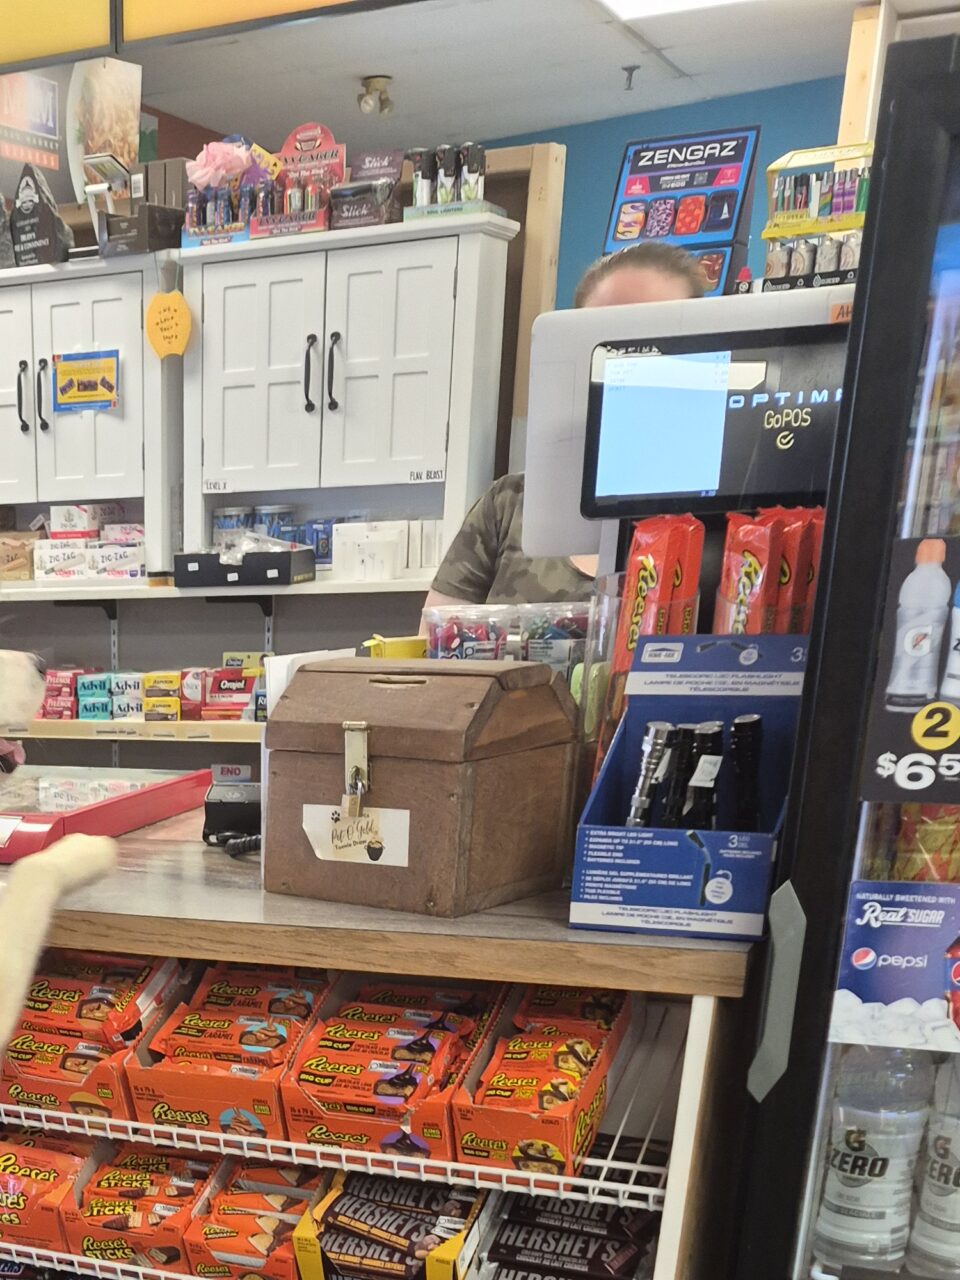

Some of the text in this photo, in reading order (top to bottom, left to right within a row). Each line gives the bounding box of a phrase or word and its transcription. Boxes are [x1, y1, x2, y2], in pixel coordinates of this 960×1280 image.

[638, 140, 738, 167] ZENGAZ
[361, 156, 391, 169] Slick
[341, 203, 370, 218] Slick
[410, 470, 443, 481] FLAV BEAST
[80, 680, 107, 692] Advil
[115, 680, 140, 692] Advil
[220, 680, 245, 692] Orajel
[82, 703, 108, 714] Advil
[117, 703, 143, 714] Advil
[922, 707, 952, 738] 2
[221, 767, 241, 776] ENO
[895, 894, 936, 904] SWEETENED
[938, 895, 955, 904] WITH
[856, 902, 945, 928] Real SUGAR
[877, 954, 928, 970] pepsi
[31, 980, 83, 1002] Reese's
[182, 1013, 232, 1030] Reese's
[326, 1024, 381, 1041] Reese's
[11, 1034, 68, 1055] Reese's
[508, 1038, 555, 1050] Reese's
[304, 1057, 364, 1076] Reese's
[492, 1074, 540, 1088] Reese's
[152, 1103, 209, 1126] Reese's
[831, 1155, 888, 1178] ZERO
[336, 1197, 432, 1242] HERSHEY'S
[83, 1237, 128, 1251] Reese's
[501, 1225, 621, 1262] HERSHEY'S
